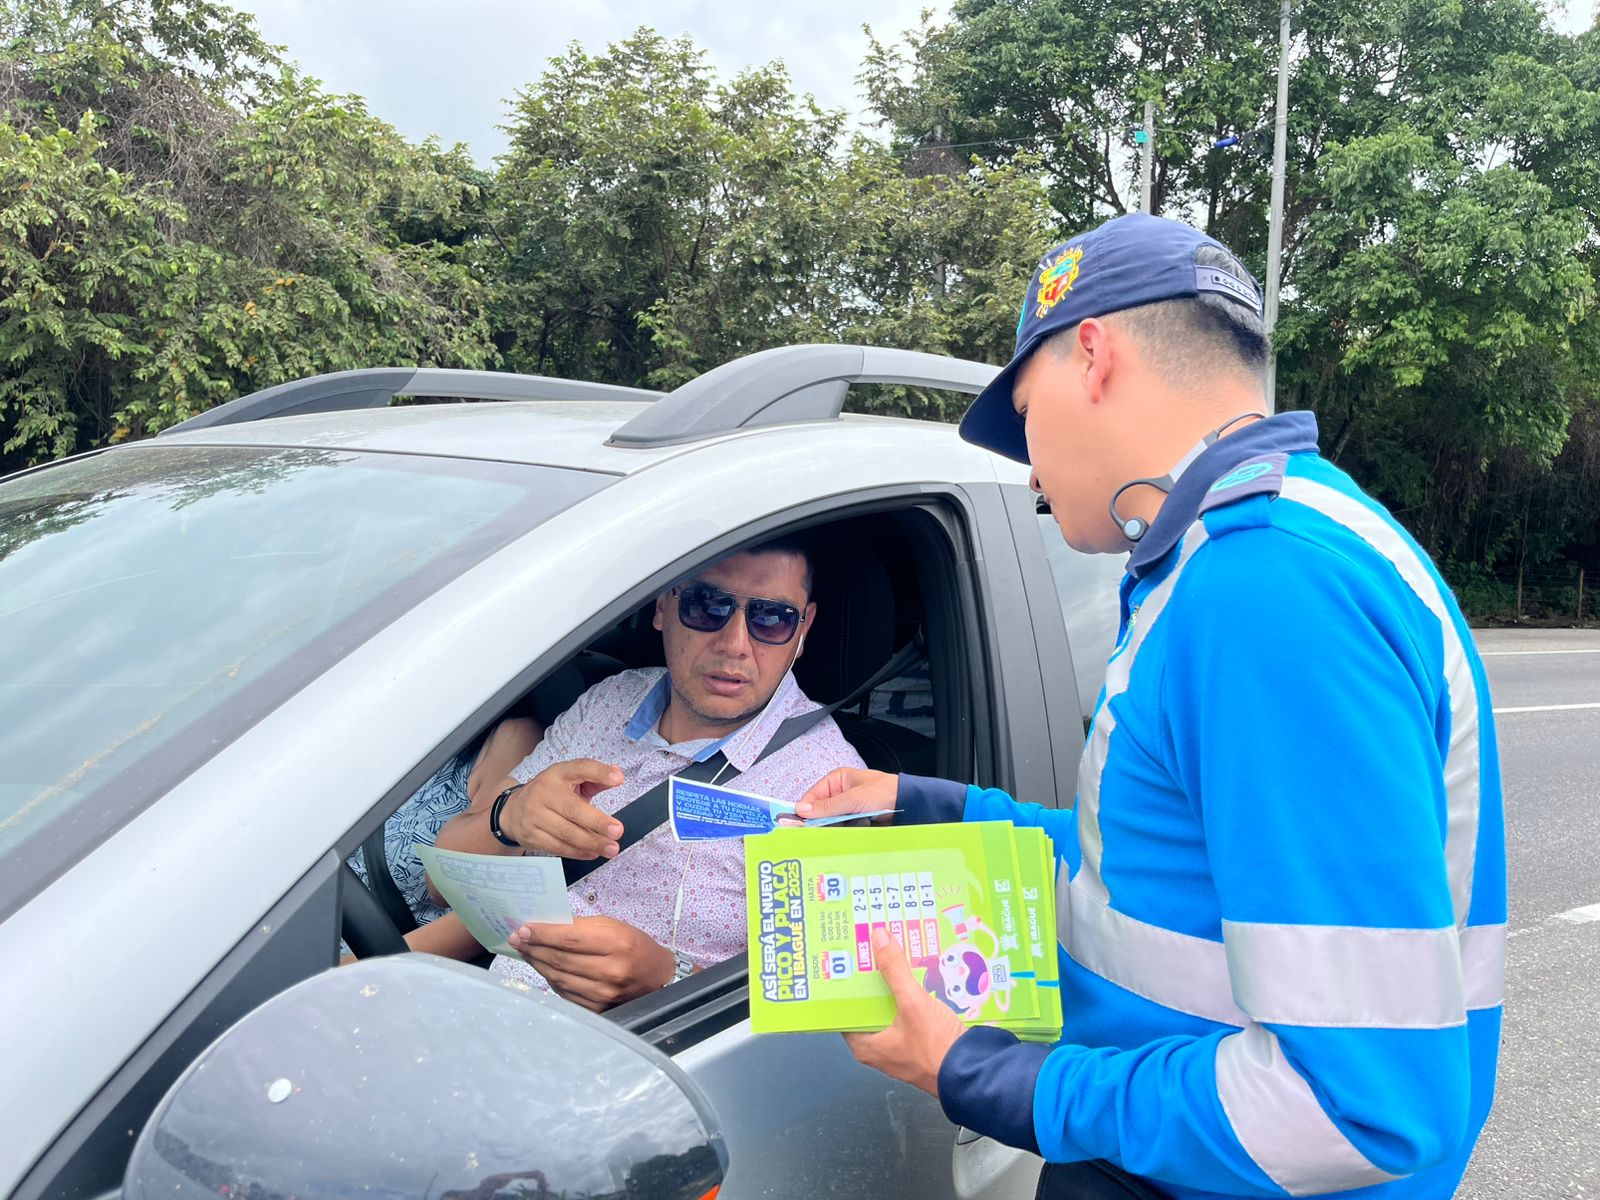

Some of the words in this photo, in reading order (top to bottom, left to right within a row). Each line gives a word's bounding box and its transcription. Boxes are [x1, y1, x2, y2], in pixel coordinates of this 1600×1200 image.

[676, 789, 710, 801] RESPETA
[711, 796, 726, 805] LAS
[676, 795, 711, 807] PROTEGE
[684, 803, 710, 813] CUIDA
[676, 807, 713, 818] NAVIDAD
[760, 862, 773, 913] NUEVO
[788, 861, 801, 896] 2025
[827, 878, 840, 896] 30
[773, 862, 791, 928] PLACA
[790, 899, 802, 918] EN
[763, 915, 774, 932] EL
[776, 932, 791, 947] Y
[789, 921, 805, 975] IBAGUÉ
[909, 929, 921, 958] JUEVES
[926, 922, 939, 956] VIERNES
[760, 933, 777, 973] SERÁ
[859, 941, 870, 968] LUNES
[776, 951, 794, 1000] PICO
[832, 956, 845, 974] 01
[762, 974, 777, 1000] ASÍ
[794, 978, 806, 998] EN
